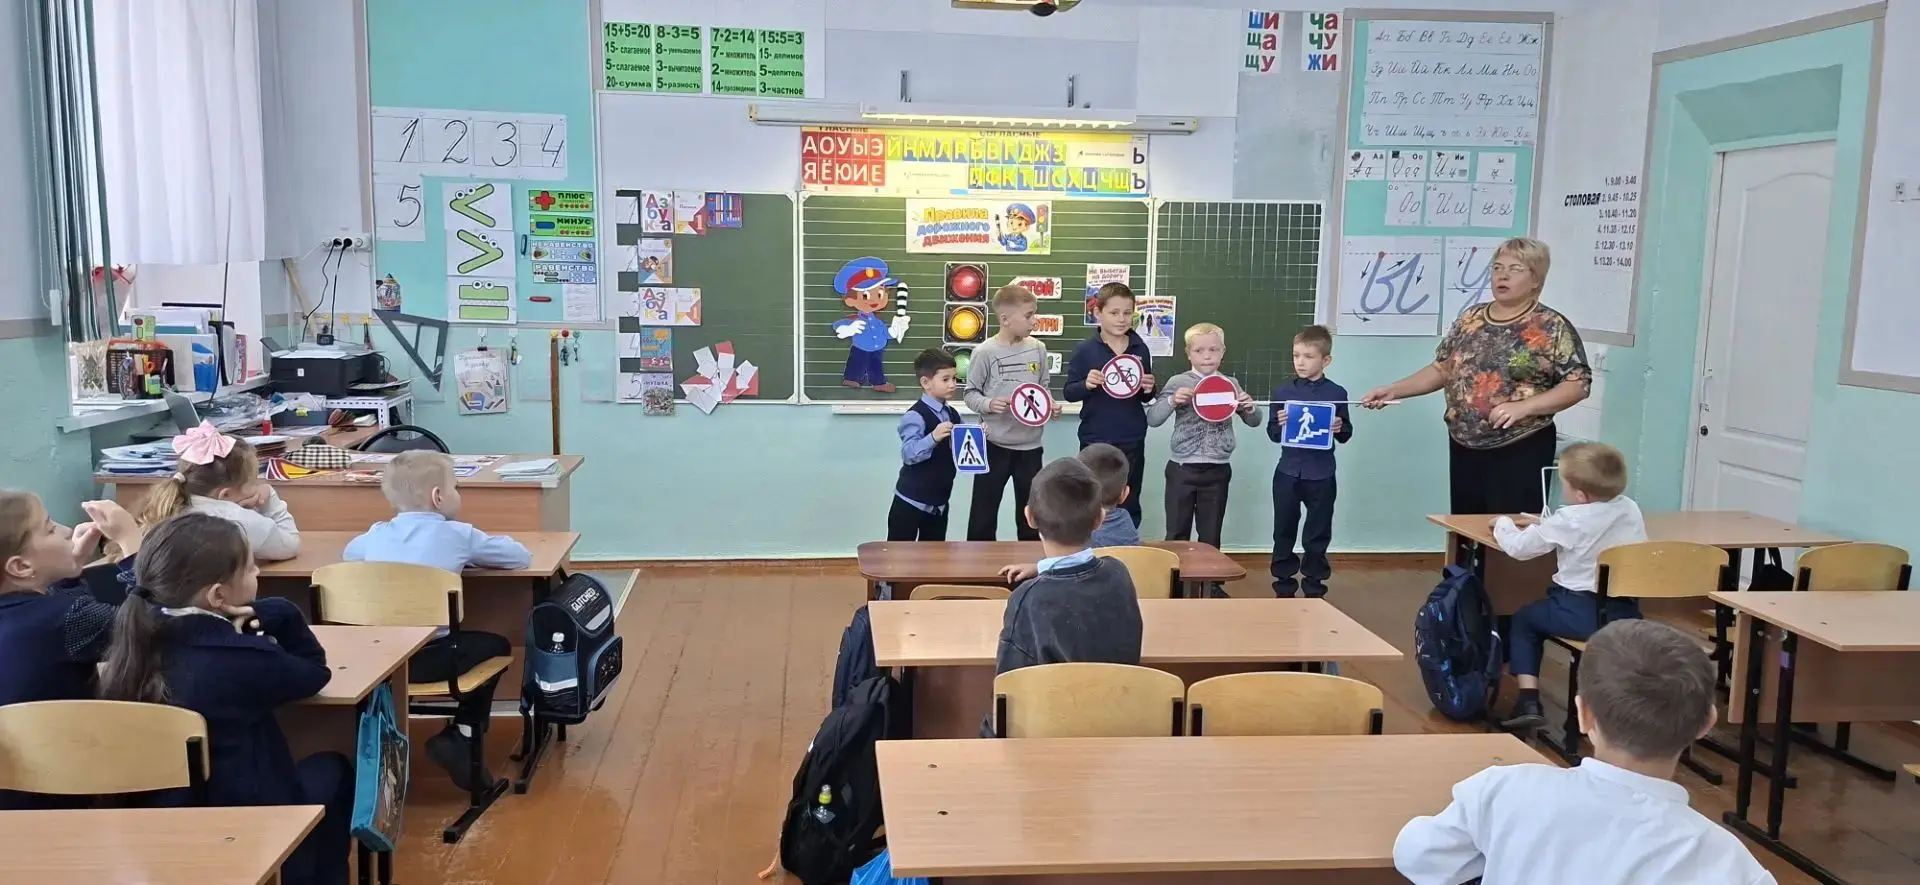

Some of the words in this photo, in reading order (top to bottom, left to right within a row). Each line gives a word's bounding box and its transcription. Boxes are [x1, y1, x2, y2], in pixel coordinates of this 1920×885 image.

[605, 23, 651, 38] 15+5=20
[761, 31, 802, 44] 15:5=3
[1247, 33, 1276, 50] ща
[1309, 33, 1337, 50] чу
[1245, 54, 1275, 72] щу
[399, 118, 420, 163] 1
[442, 119, 469, 164] 2
[491, 122, 517, 167] 3
[541, 124, 564, 167] 4
[558, 192, 585, 200] ПЛЮС
[393, 185, 421, 227] 5
[556, 217, 591, 225] МИНУС
[924, 207, 988, 222] Правила
